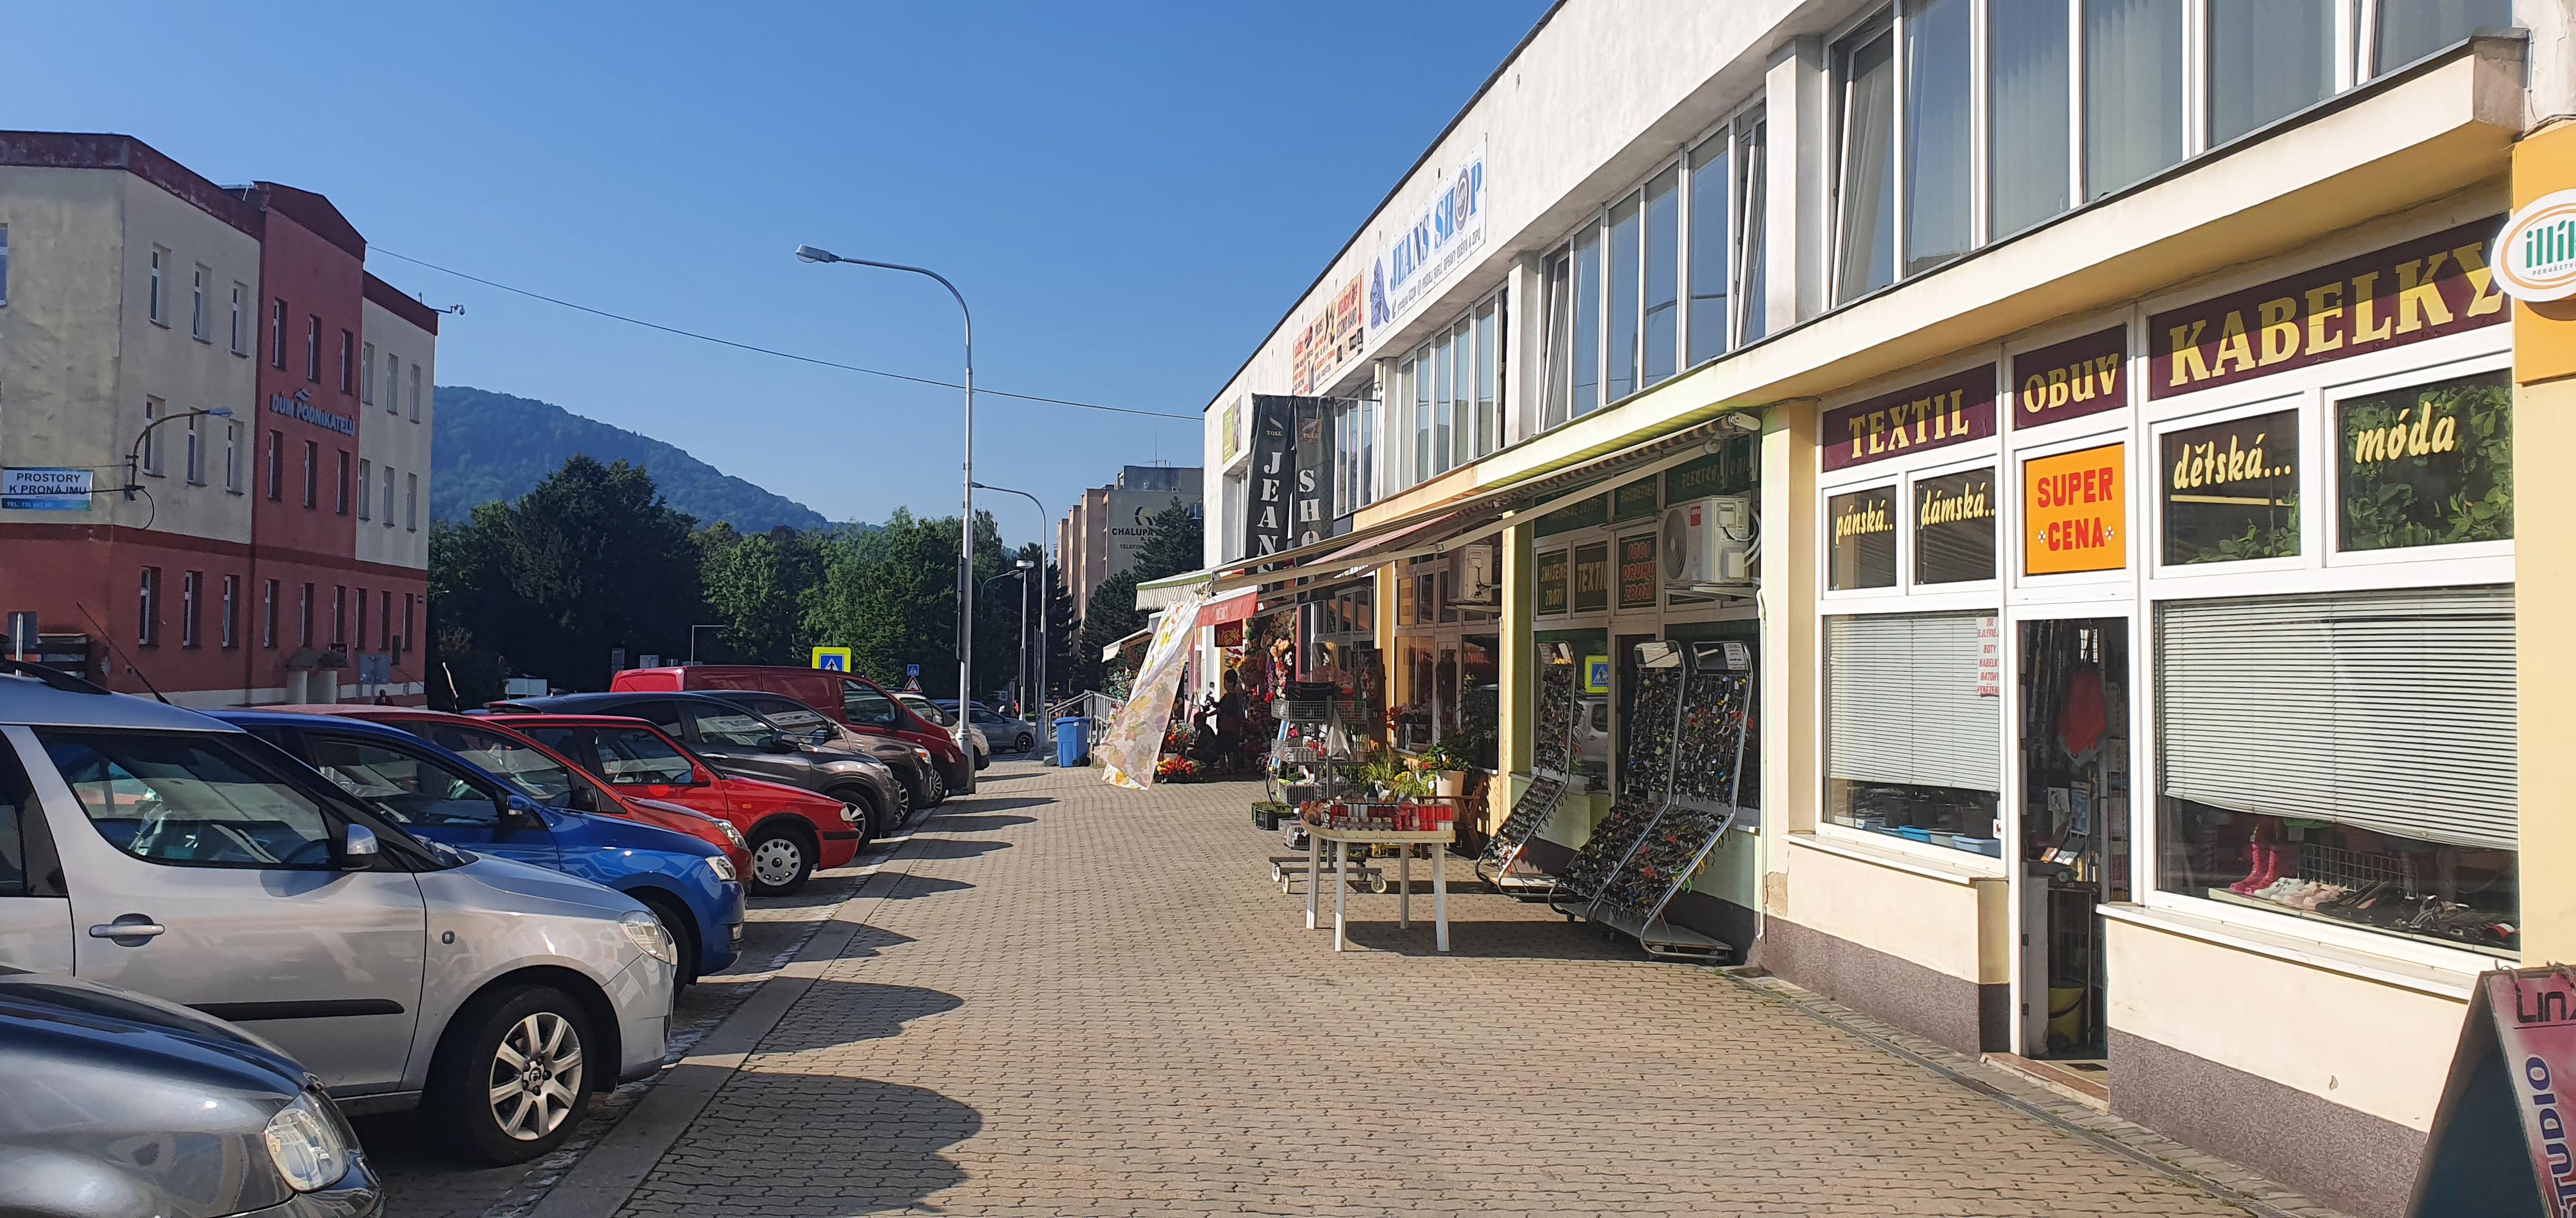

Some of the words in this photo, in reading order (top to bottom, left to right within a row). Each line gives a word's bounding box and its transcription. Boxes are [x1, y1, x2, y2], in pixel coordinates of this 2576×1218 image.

[1390, 212, 1430, 292] JEANS
[1435, 160, 1482, 250] SHOP
[2532, 263, 2576, 276] PEKAŘSTV
[2169, 239, 2504, 387] KABELKY
[2023, 353, 2119, 413] OBUV
[1848, 389, 1969, 459] TEXTIL
[2354, 401, 2456, 464] móda
[17, 473, 80, 483] PROSTORY
[2174, 433, 2291, 490] dětská...
[9, 485, 17, 494] K
[21, 484, 86, 494] PRONÁJMU
[2037, 467, 2114, 508] SUPER
[1299, 469, 1321, 547] SHO
[1627, 541, 1651, 560] 1001
[2047, 518, 2105, 552] CENA
[1622, 557, 1656, 581] DRUHŮ
[1624, 577, 1654, 601] ZBOŽÍ
[1979, 659, 1998, 667] KABELK
[1984, 644, 1997, 653] BOTY
[2517, 989, 2576, 1024] LIN
